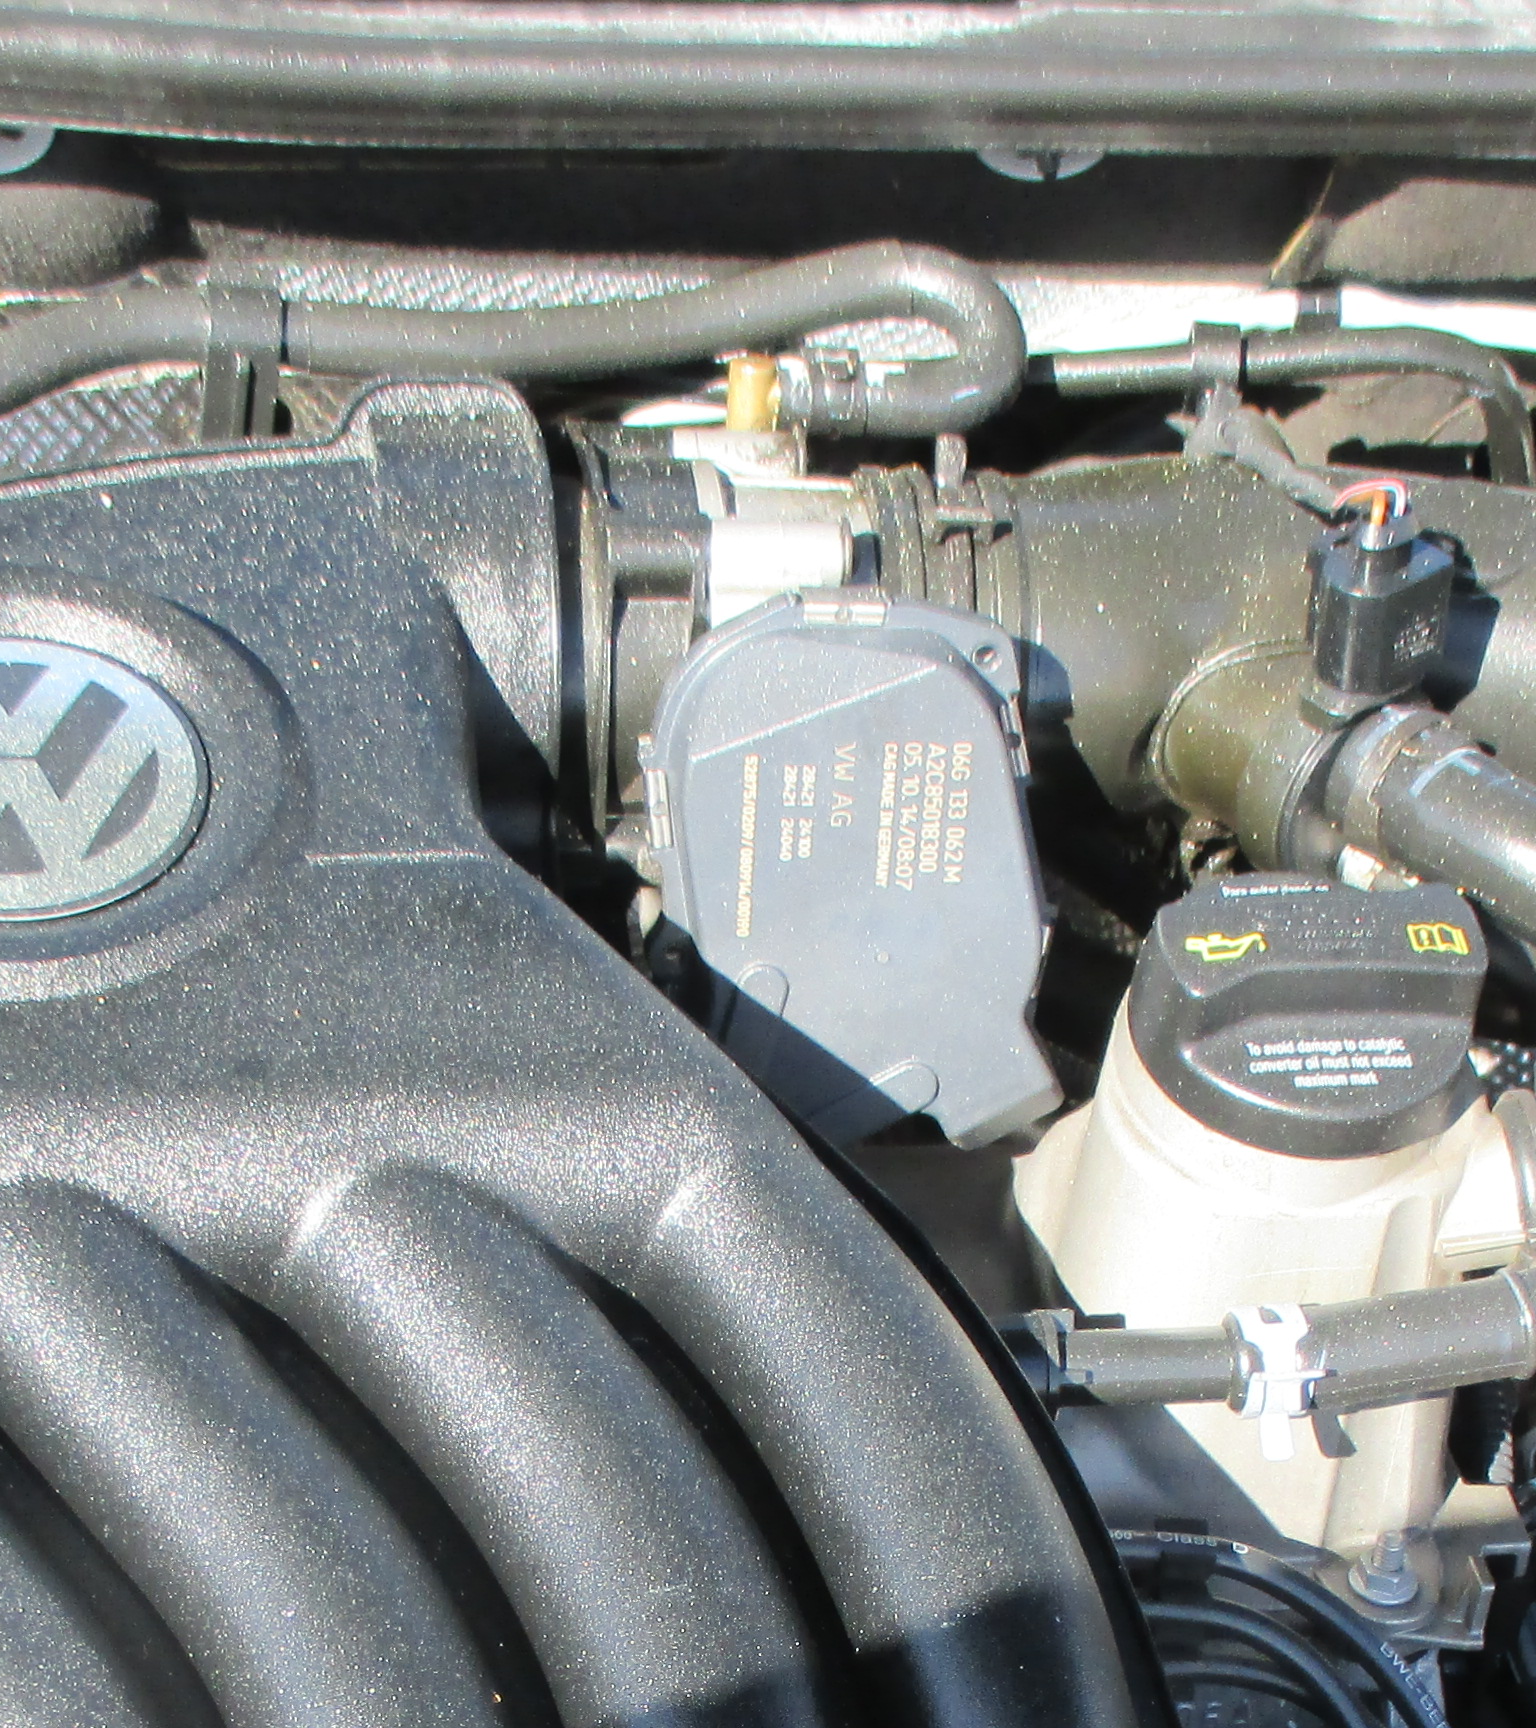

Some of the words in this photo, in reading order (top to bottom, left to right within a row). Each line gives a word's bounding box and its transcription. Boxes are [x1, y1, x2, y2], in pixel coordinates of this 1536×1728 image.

[833, 741, 857, 782] VW
[951, 742, 973, 781] 06G
[782, 764, 798, 807] 28421
[801, 764, 816, 807] 28421
[880, 771, 897, 810] MADE
[948, 788, 968, 820] 133
[830, 791, 856, 828] AG
[879, 809, 894, 827] IN
[919, 742, 948, 873] A2C85018300
[779, 818, 794, 862] 24040
[797, 818, 813, 859] 24100
[875, 827, 893, 888] GERMANY
[1245, 1041, 1263, 1057] To
[1263, 1040, 1295, 1055] avoid
[1296, 1038, 1343, 1056] damage
[1343, 1038, 1357, 1052] to
[1357, 1037, 1406, 1055] catalytic
[1249, 1058, 1303, 1074] converter
[1305, 1055, 1321, 1070] oil
[1321, 1055, 1350, 1069] must
[1351, 1054, 1371, 1068] not
[1371, 1053, 1414, 1069] exceed
[1293, 1073, 1349, 1088] maximum
[1156, 1530, 1218, 1548] Class
[1231, 1542, 1250, 1555] D
